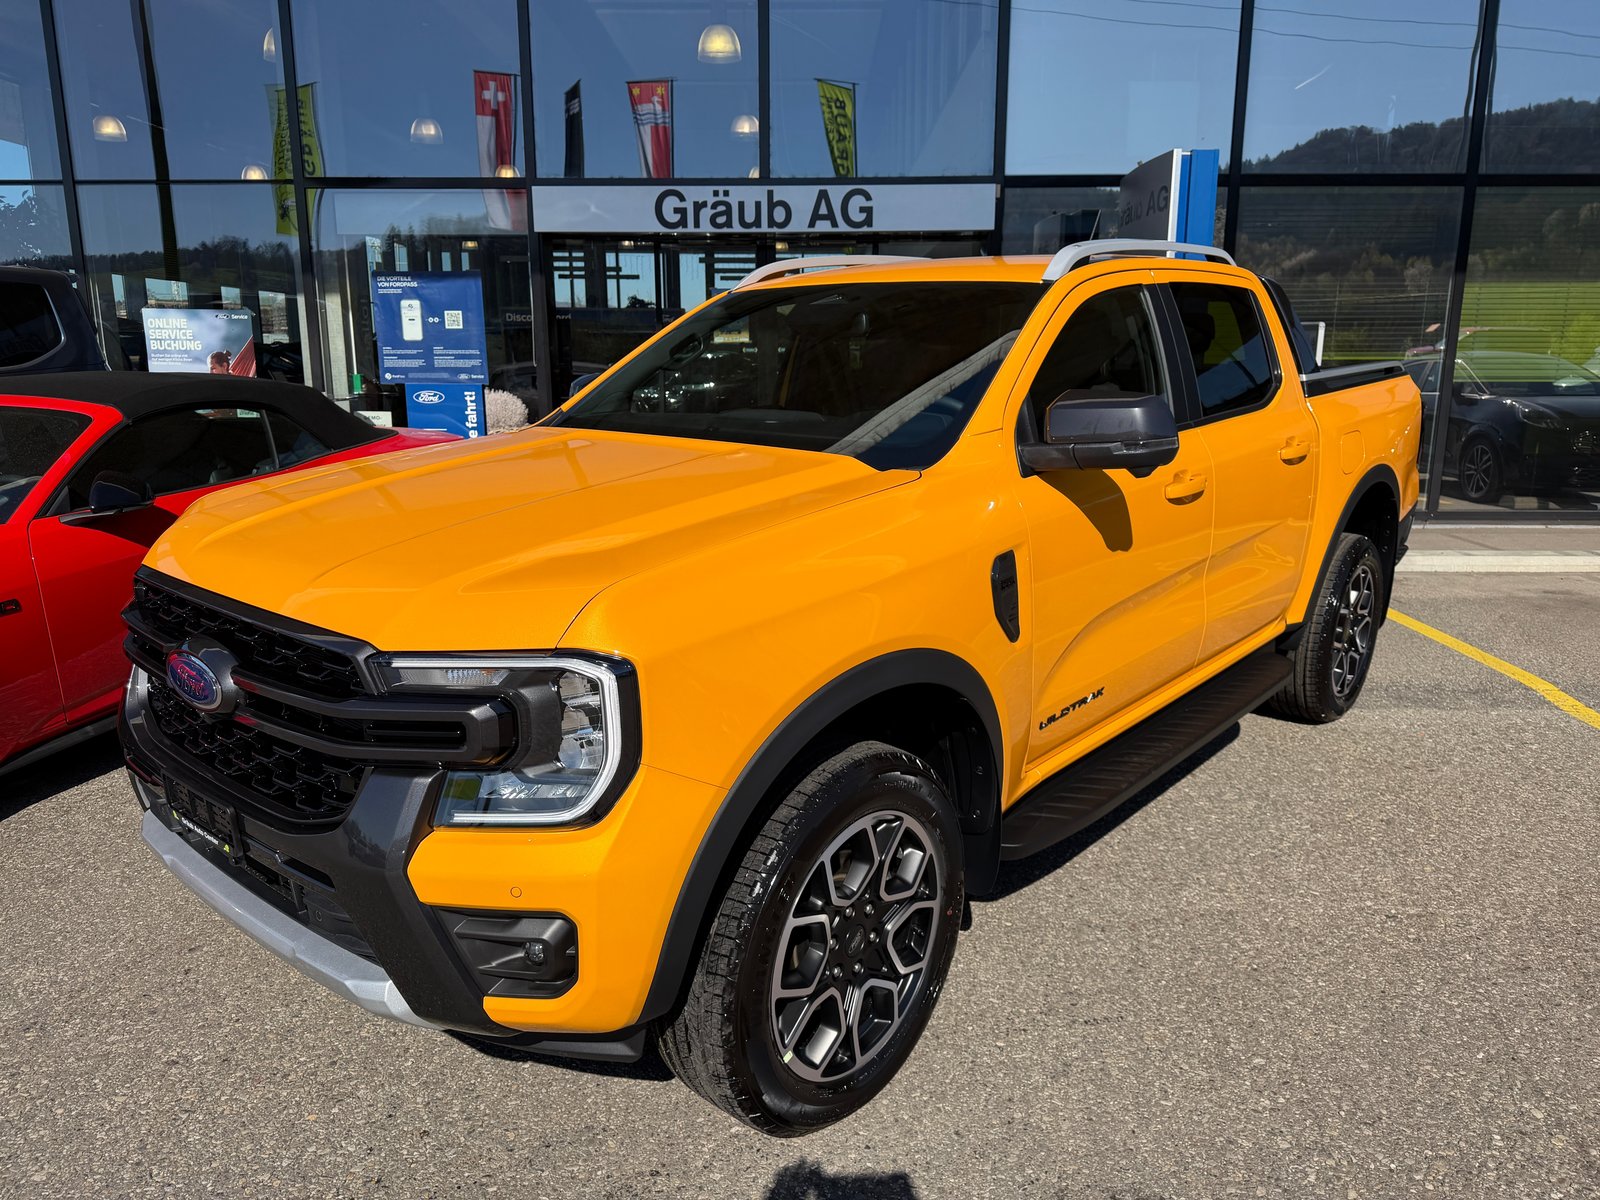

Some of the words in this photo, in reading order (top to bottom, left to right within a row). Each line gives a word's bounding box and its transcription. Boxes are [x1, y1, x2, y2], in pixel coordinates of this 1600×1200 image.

[1146, 185, 1169, 217] AG
[654, 188, 793, 230] Gräub
[807, 188, 874, 229] AG
[505, 313, 533, 322] Disco
[147, 318, 188, 329] ONLINE
[149, 329, 194, 340] SERVICE
[150, 340, 202, 351] BUCHUNG
[418, 392, 440, 402] Ford
[464, 391, 478, 429] fahrt!
[1039, 686, 1105, 731] WILDTRAK
